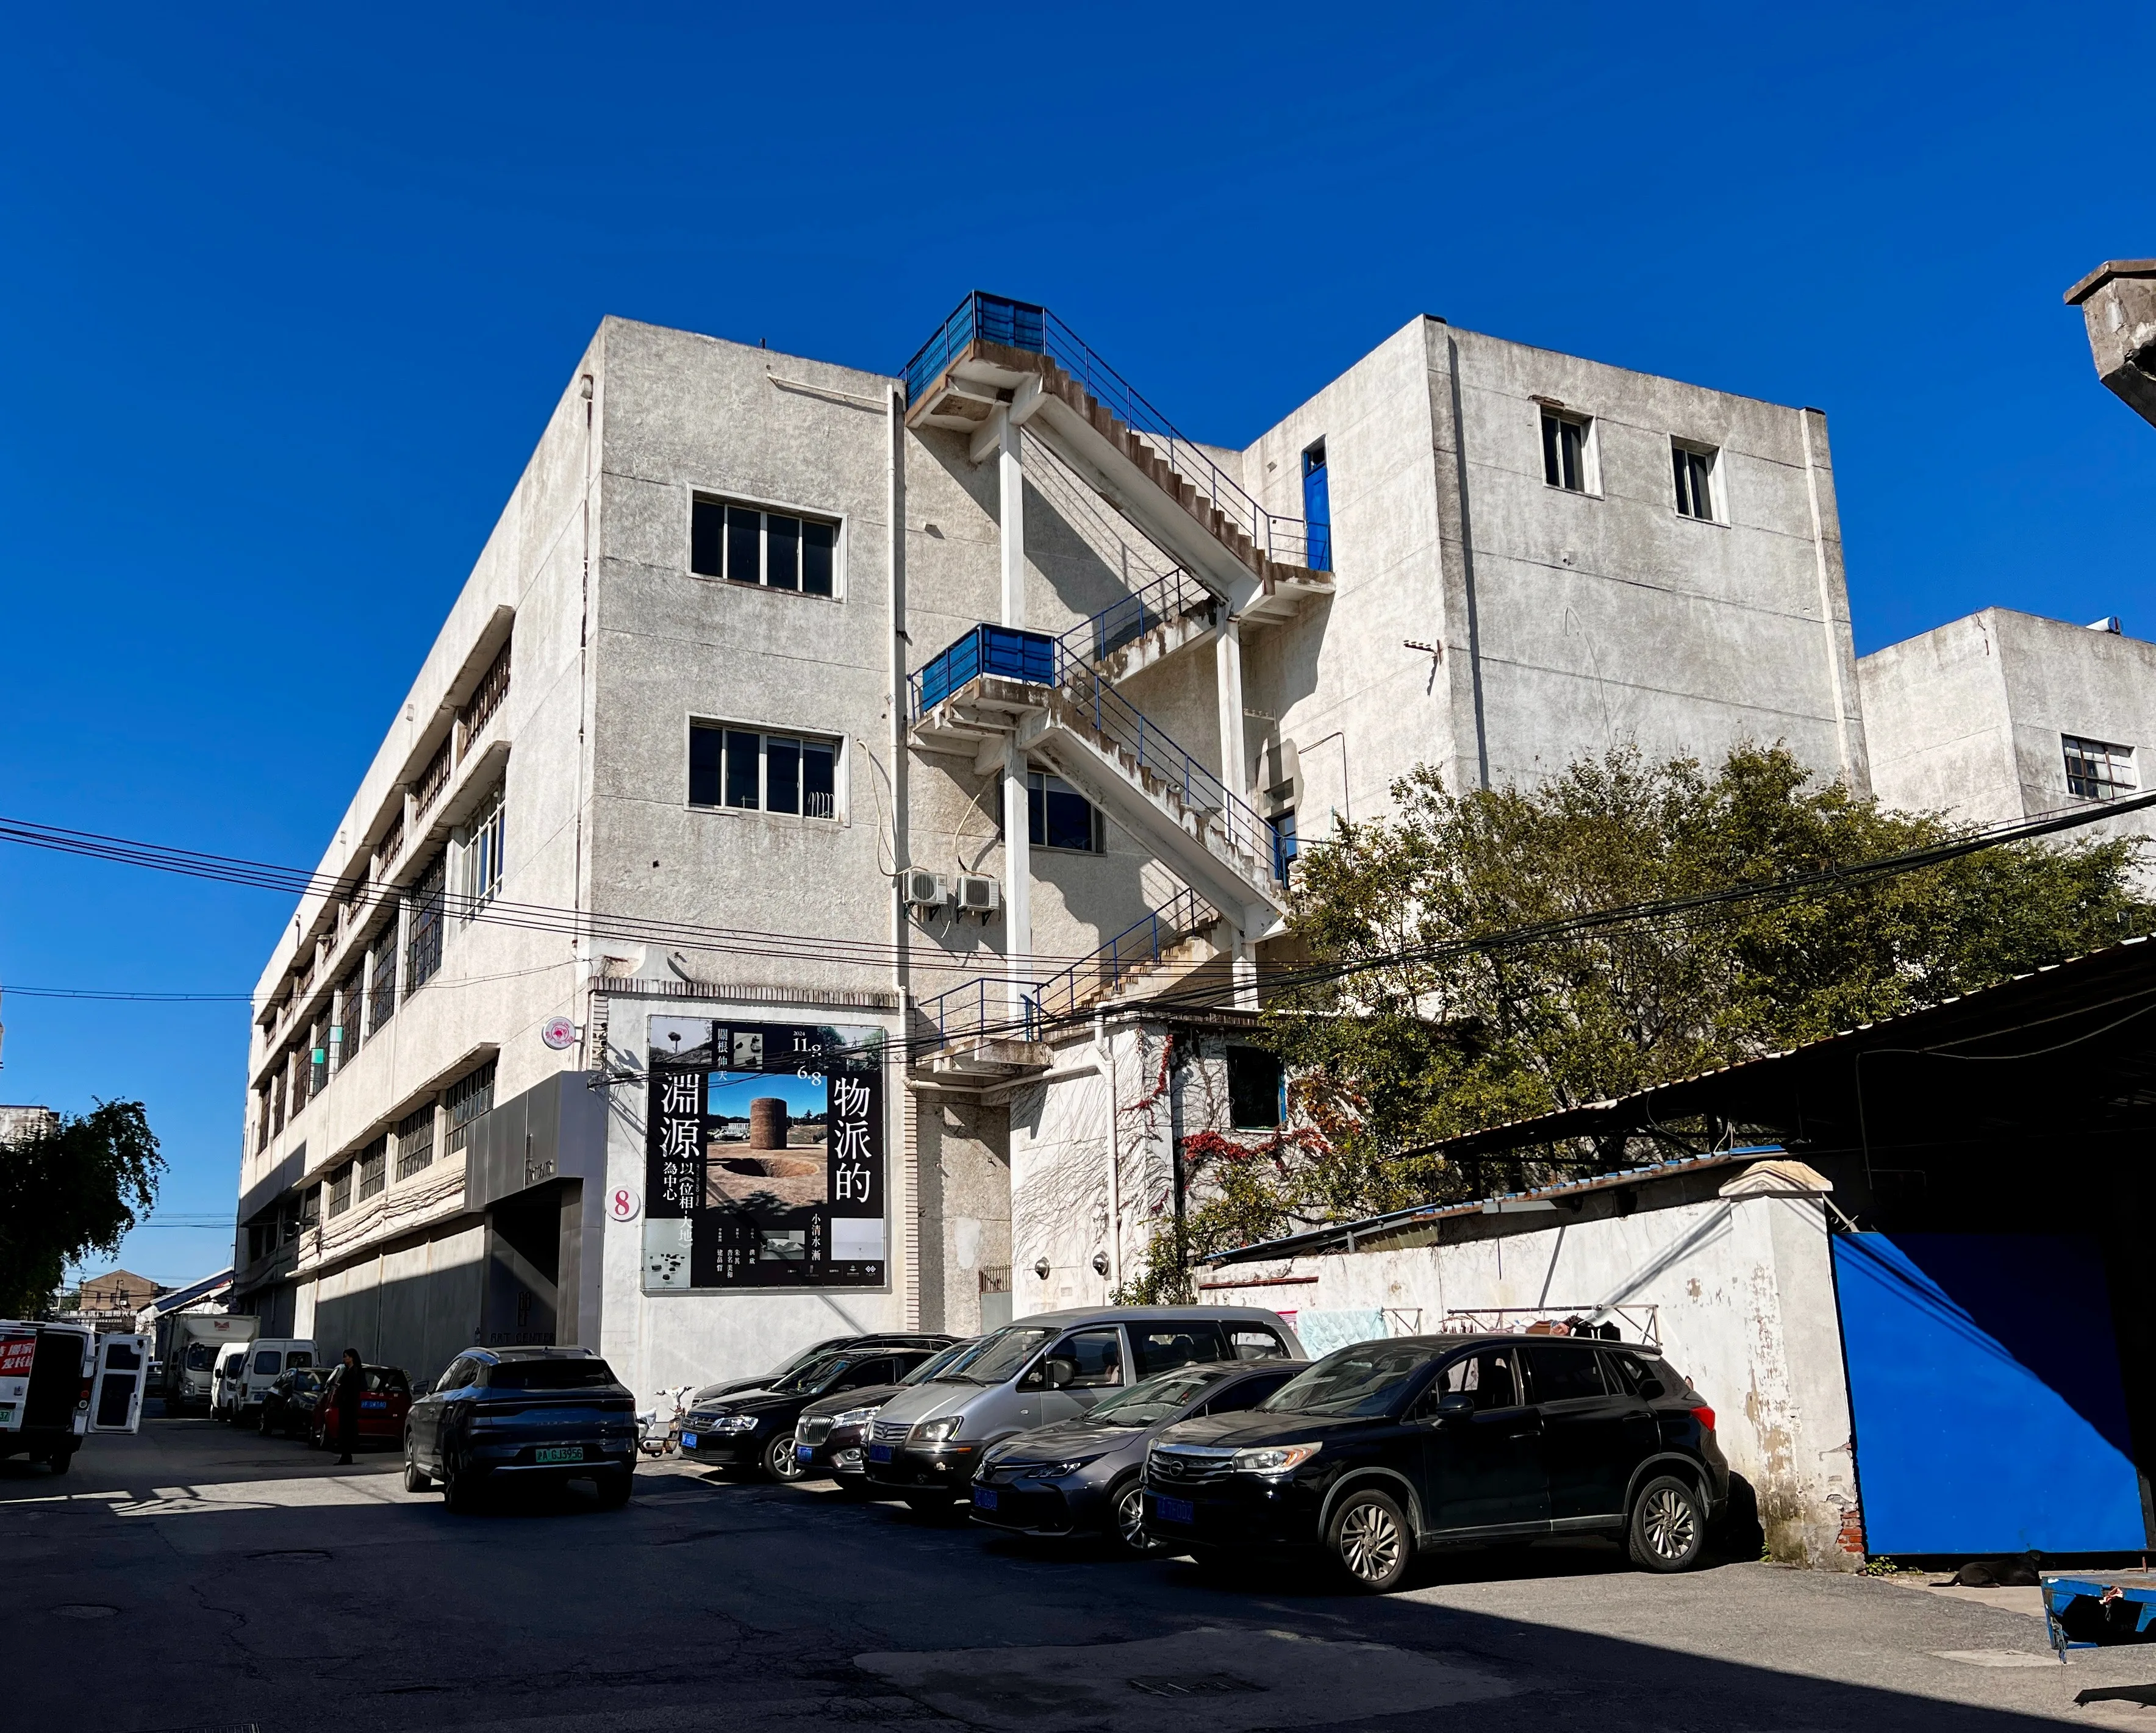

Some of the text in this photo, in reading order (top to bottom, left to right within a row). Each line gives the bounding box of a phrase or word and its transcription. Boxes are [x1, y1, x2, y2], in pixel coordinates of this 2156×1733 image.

[797, 1065, 822, 1087] 6.8
[659, 1072, 700, 1159] 淵源
[834, 1076, 873, 1204] 物派的
[662, 1162, 678, 1201] 為中心
[614, 1190, 631, 1216] 8
[811, 1213, 821, 1261] 小清水漸
[490, 1332, 510, 1343] ART
